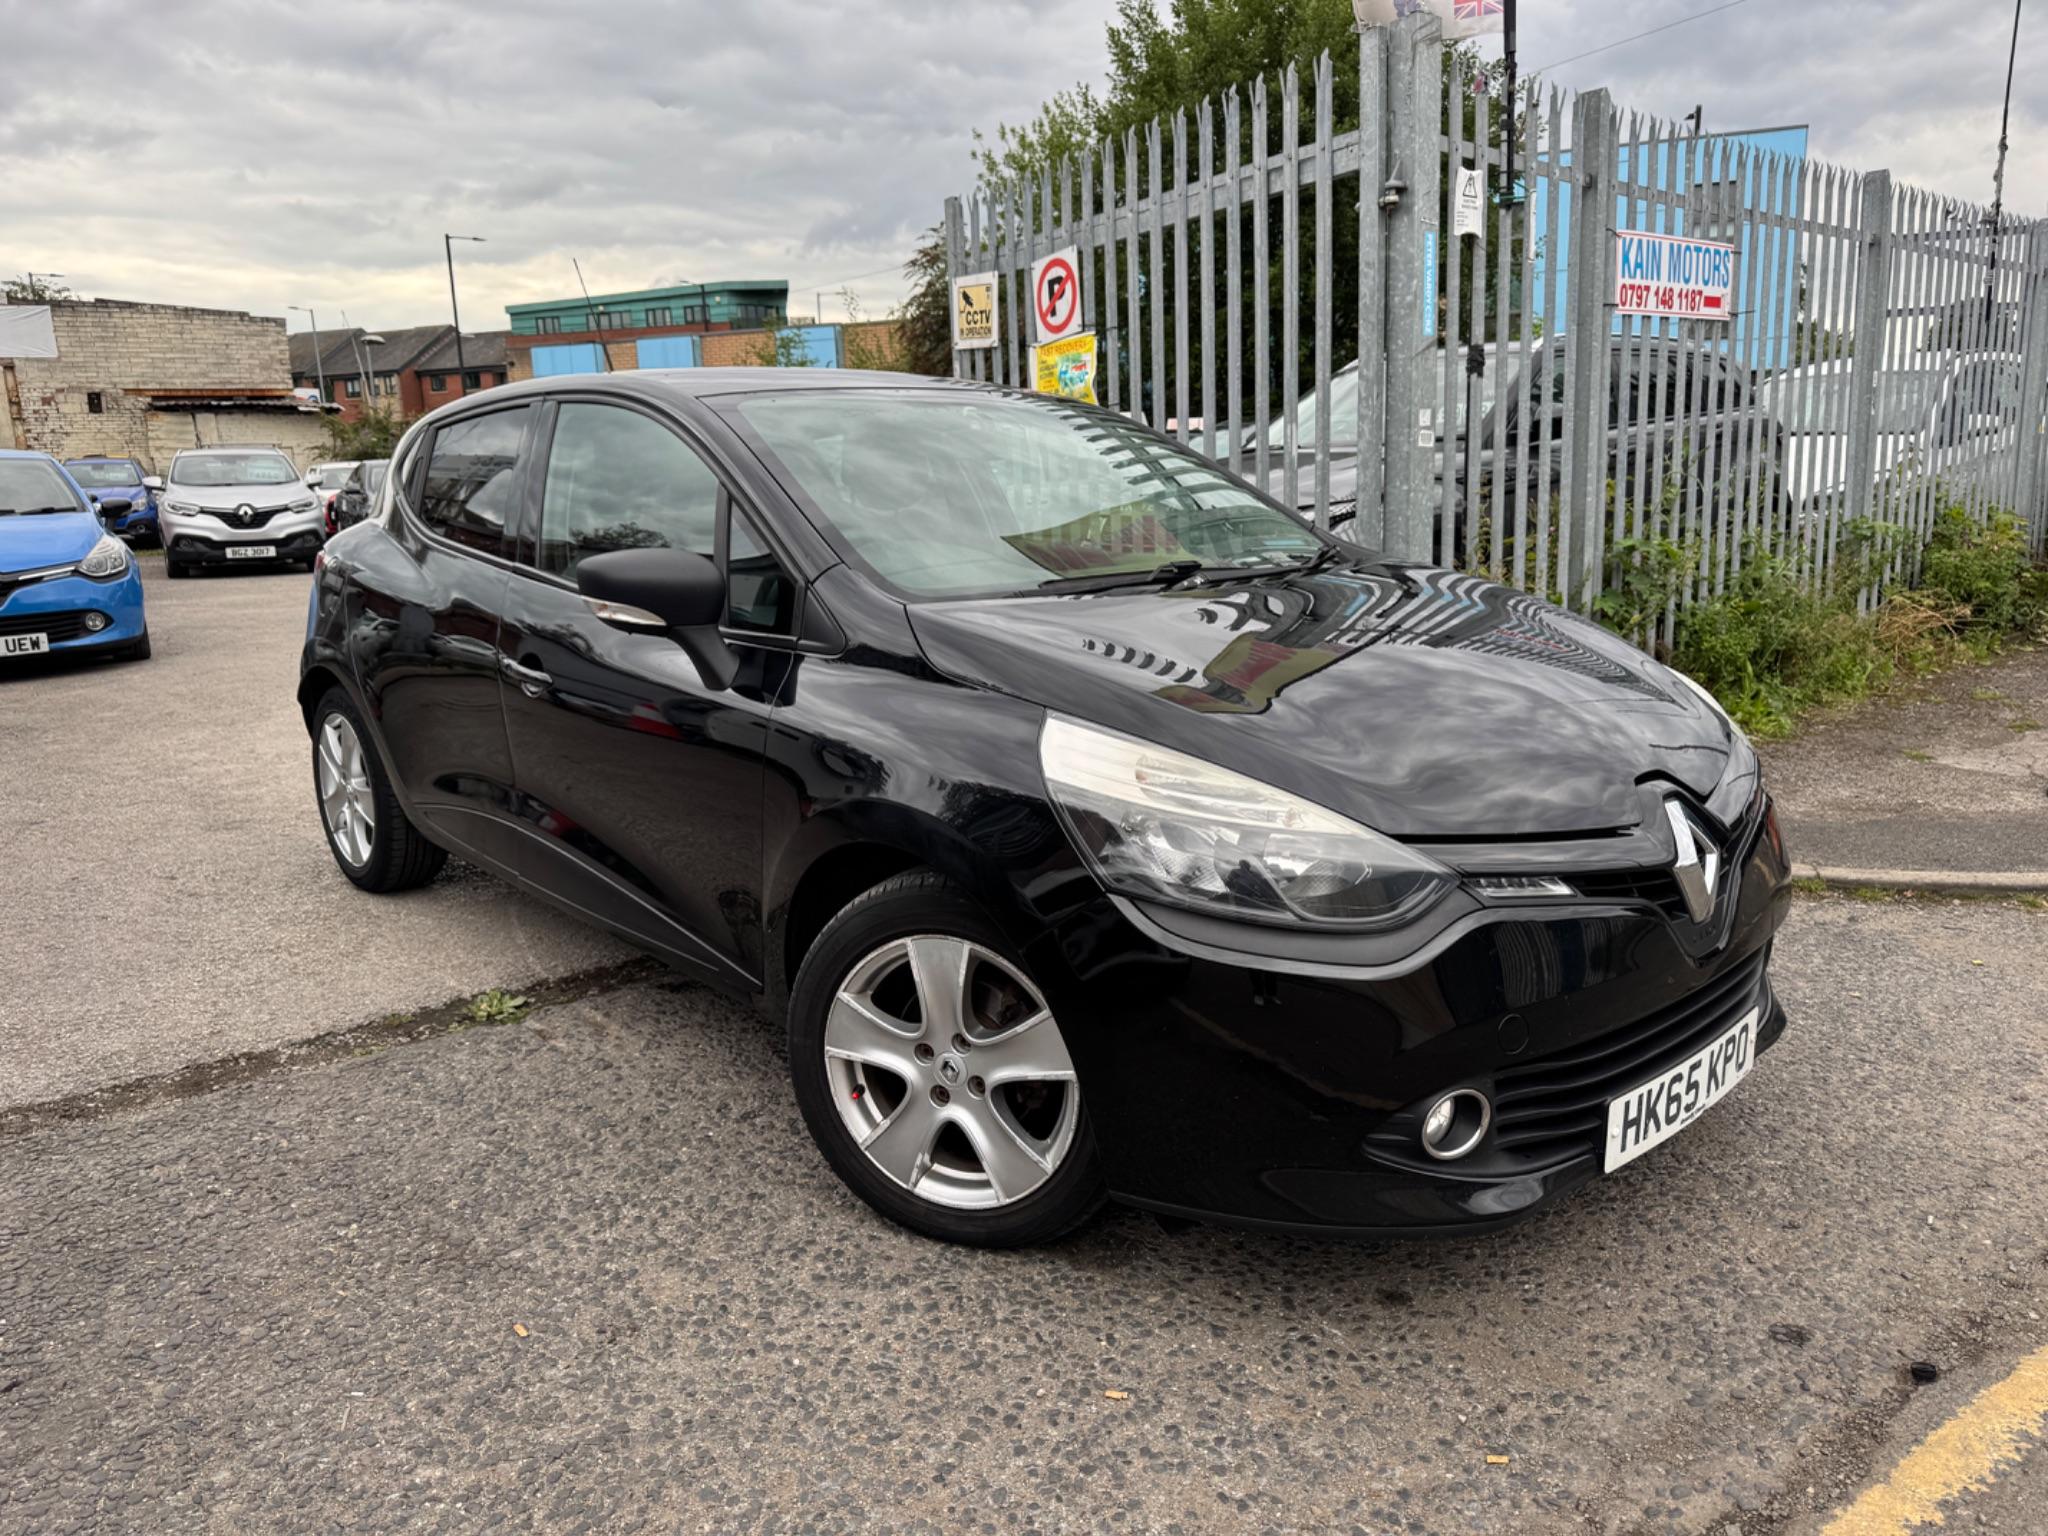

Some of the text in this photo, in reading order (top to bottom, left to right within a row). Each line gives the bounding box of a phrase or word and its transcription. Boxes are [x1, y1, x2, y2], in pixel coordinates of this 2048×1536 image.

[1621, 237, 1730, 288] KAIN MOTORS
[1047, 275, 1066, 317] P
[1619, 283, 1703, 312] 0797 148 1187
[966, 309, 991, 326] CCTV
[4, 635, 41, 653] UEW
[1620, 1022, 1749, 1153] HK65 KPO
